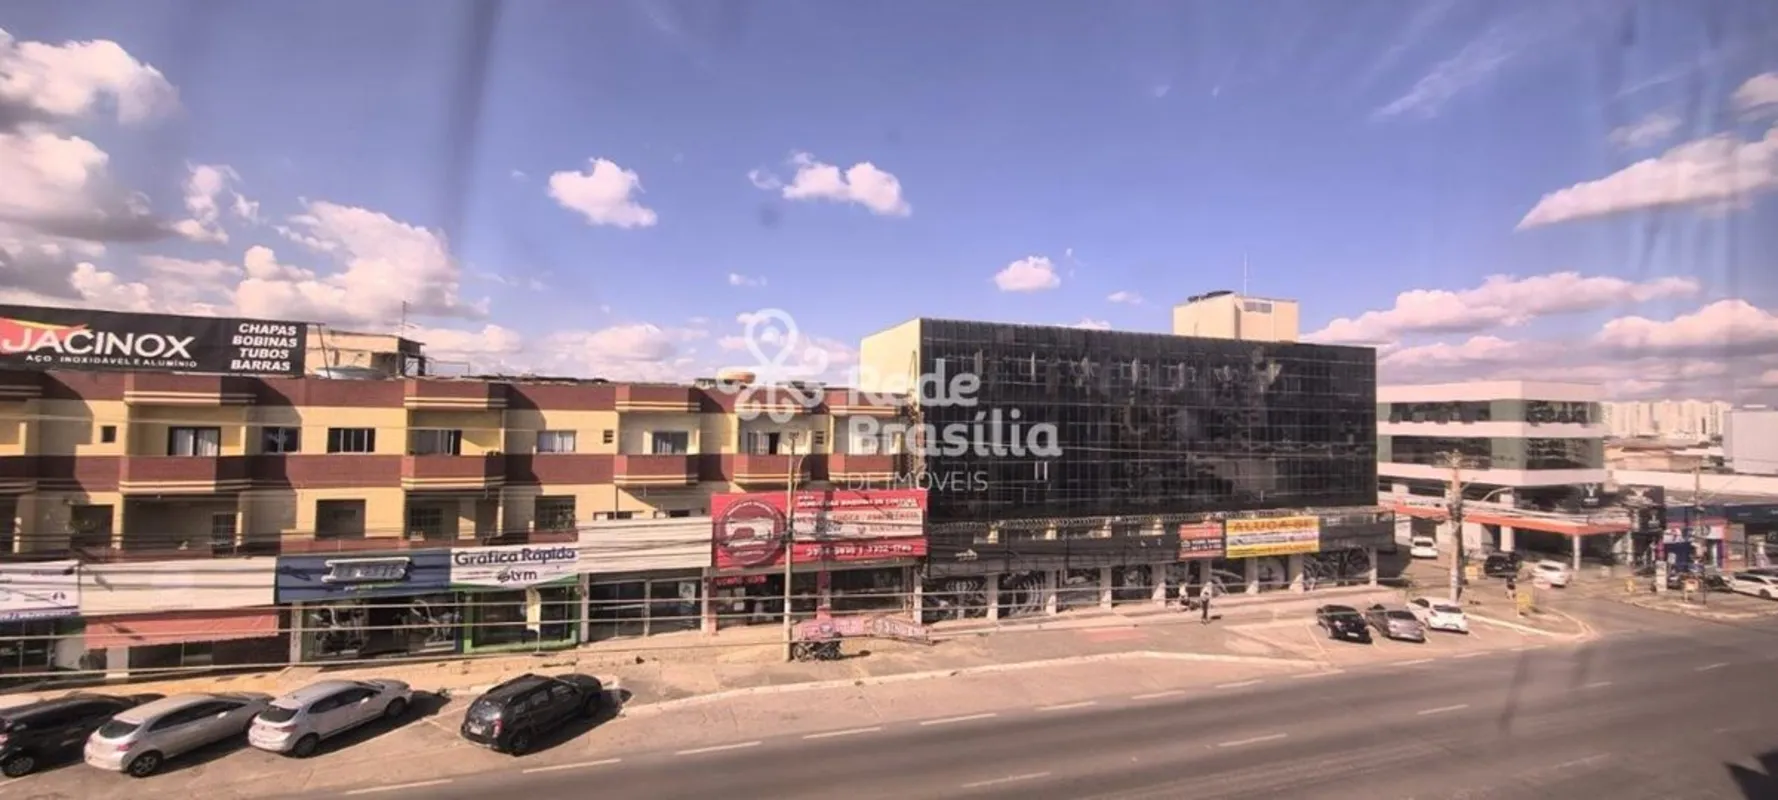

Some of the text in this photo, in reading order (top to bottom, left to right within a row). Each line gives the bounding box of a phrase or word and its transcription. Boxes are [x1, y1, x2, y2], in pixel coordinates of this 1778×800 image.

[238, 323, 297, 336] CHAPAS
[2, 326, 196, 359] JACINOX
[232, 335, 298, 348] BOBINAS
[239, 347, 290, 359] TUBOS
[26, 354, 53, 363] AÇO
[134, 358, 140, 366] E
[230, 359, 291, 371] BARRAS
